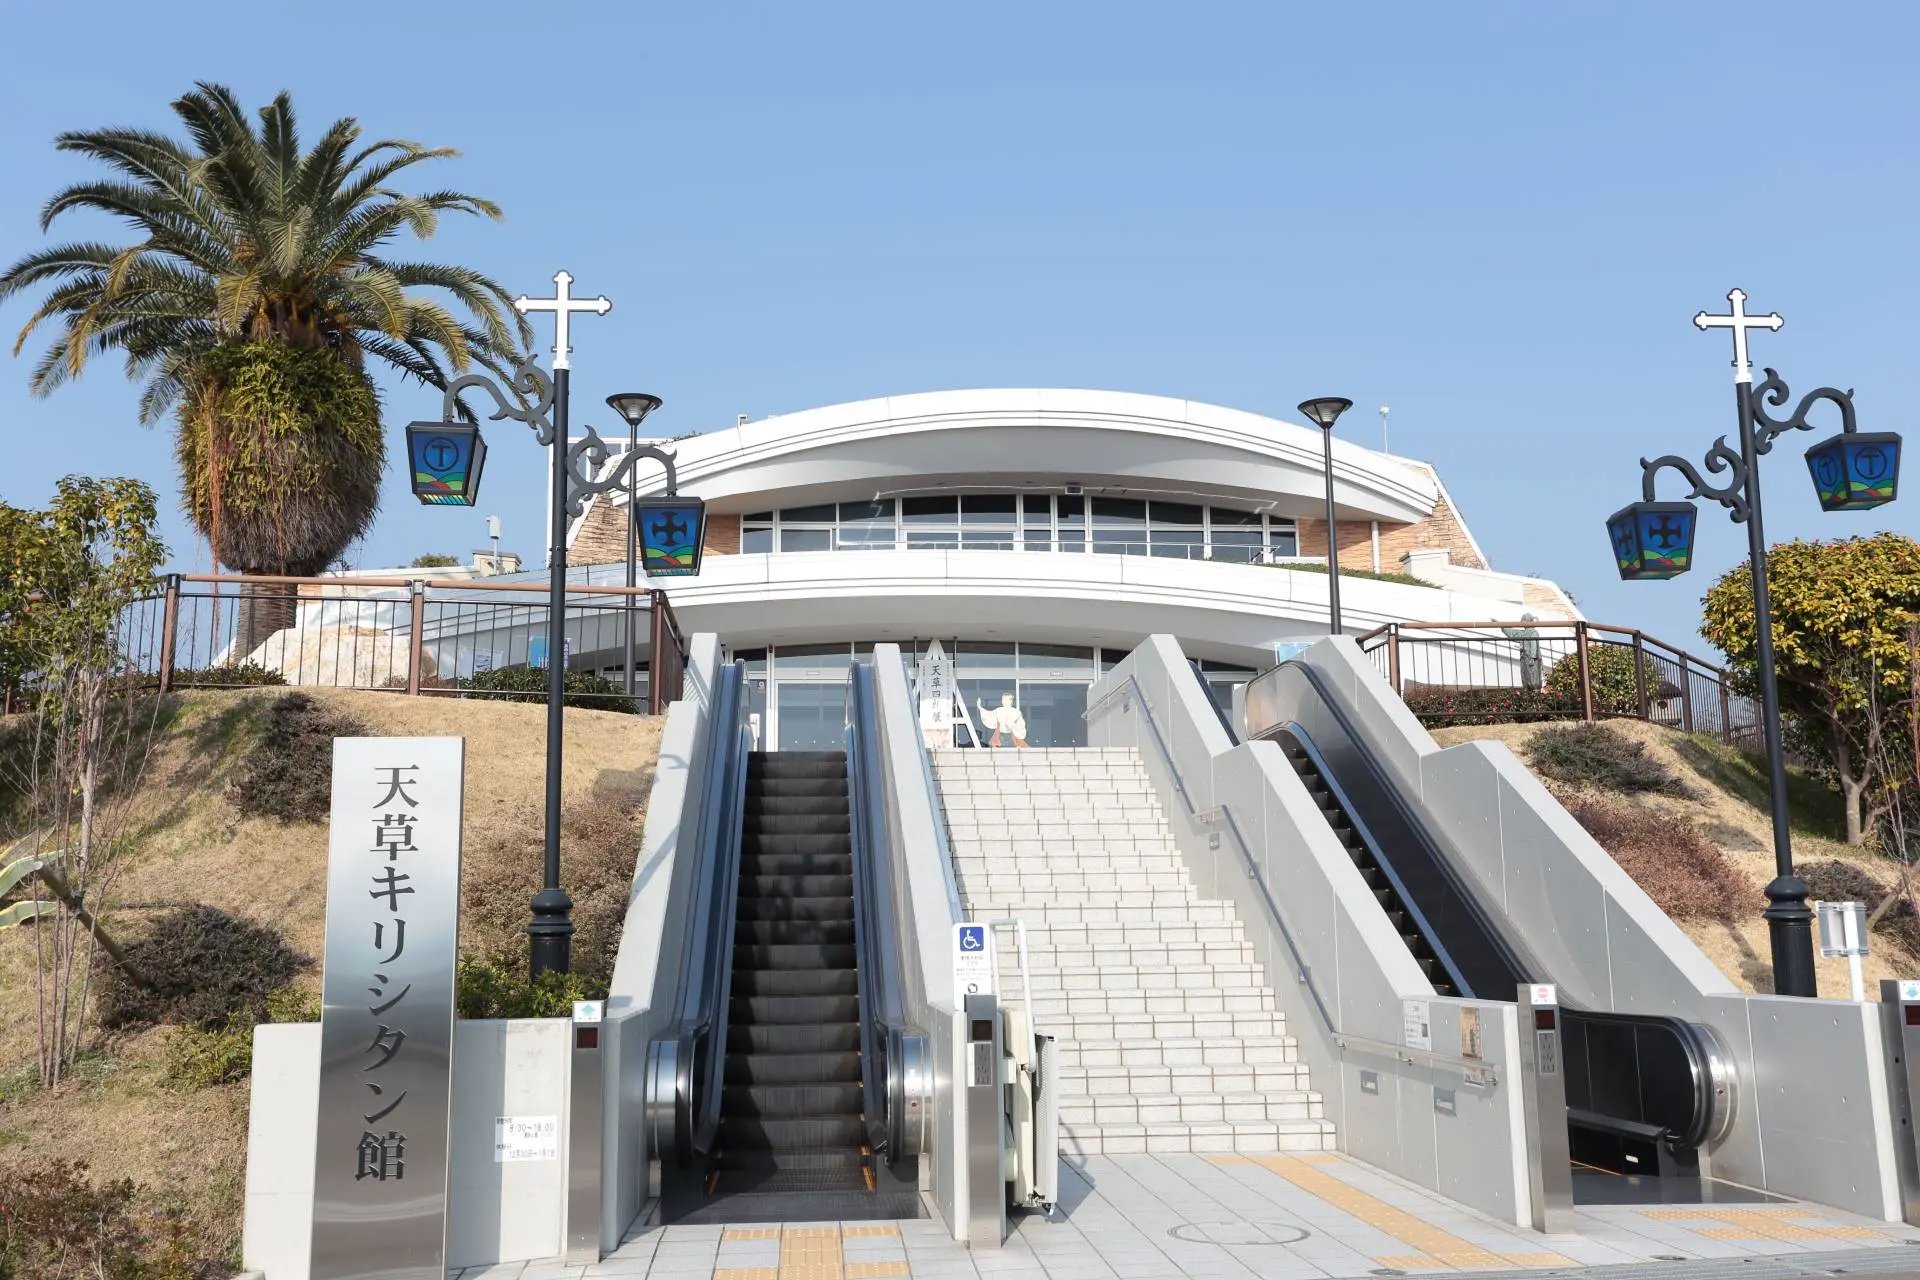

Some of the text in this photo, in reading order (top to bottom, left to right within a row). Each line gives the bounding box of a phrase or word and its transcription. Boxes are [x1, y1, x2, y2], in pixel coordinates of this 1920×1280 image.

[355, 764, 419, 1182] 天草キリシタン館
